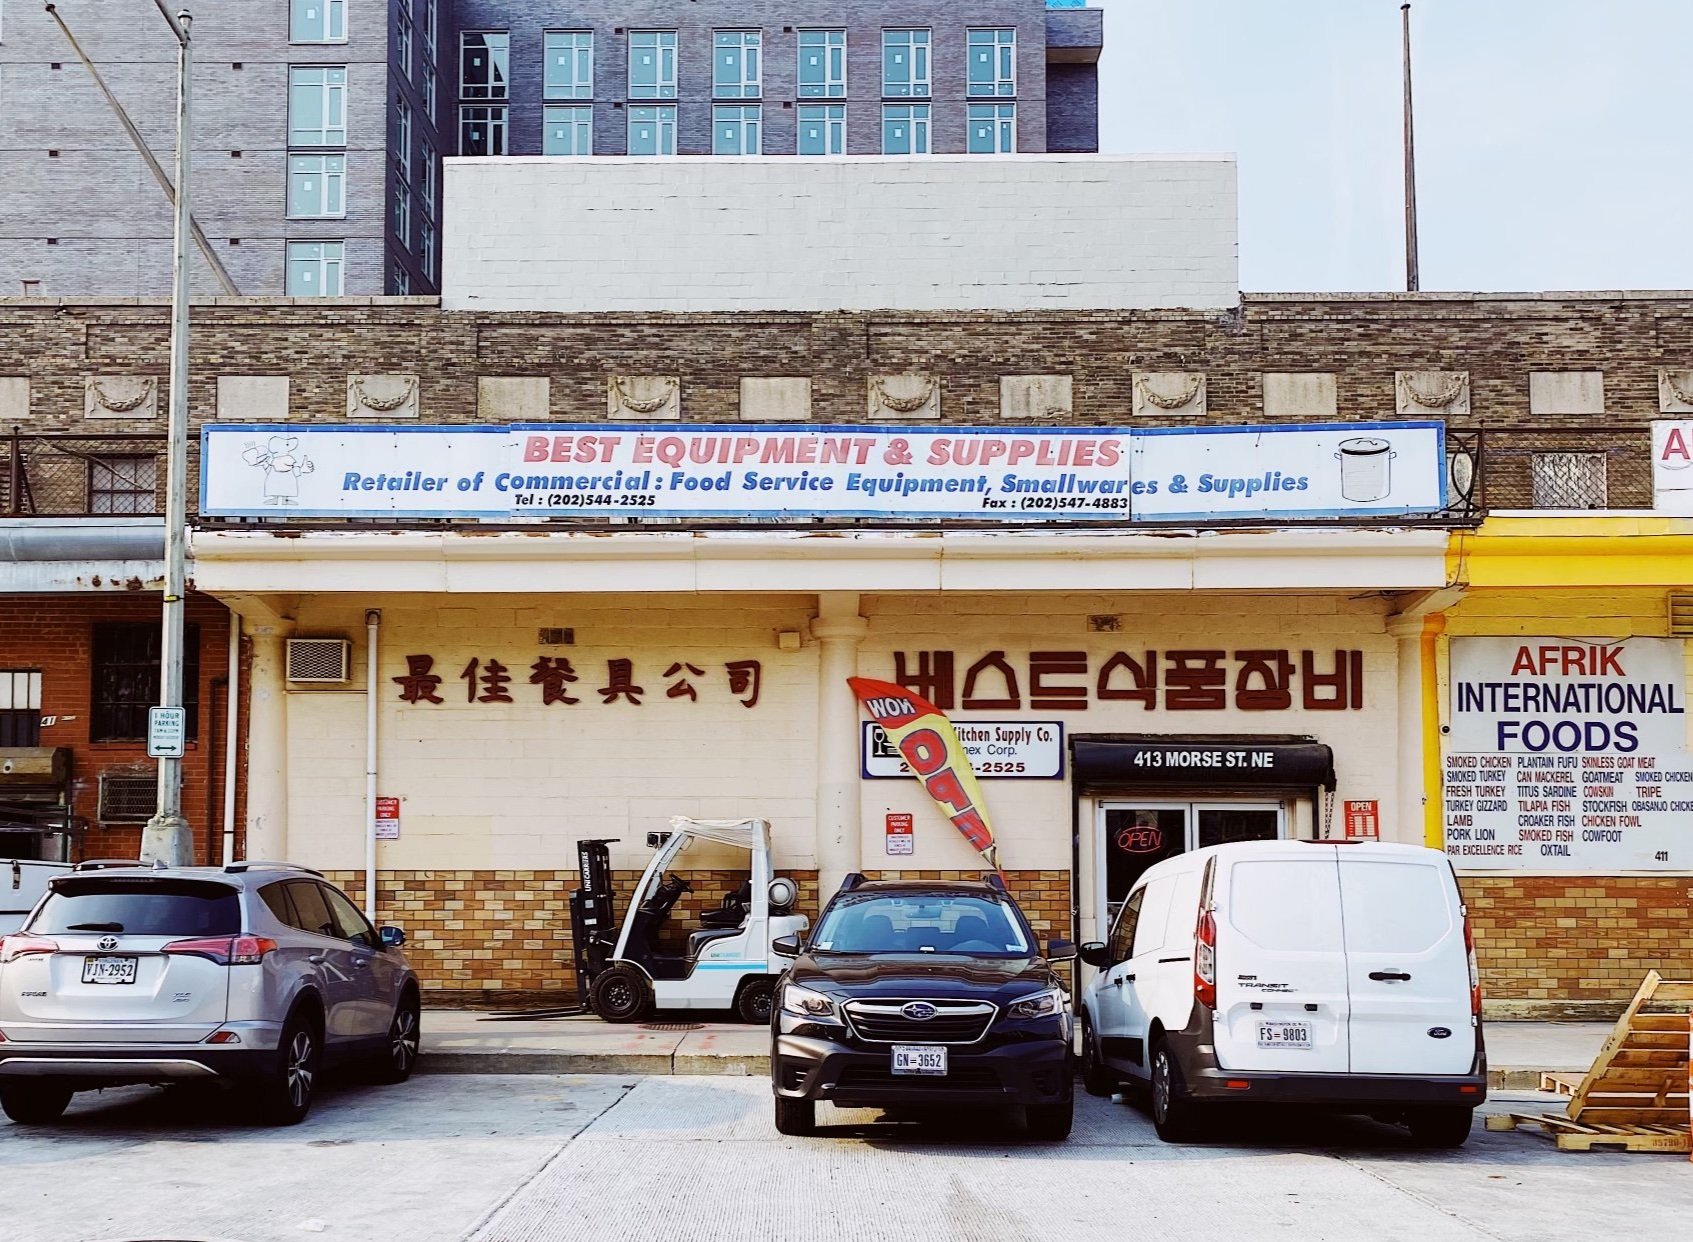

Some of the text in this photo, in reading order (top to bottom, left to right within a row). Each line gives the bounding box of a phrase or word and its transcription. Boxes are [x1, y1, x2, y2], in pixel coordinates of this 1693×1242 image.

[1662, 428, 1693, 461] A
[523, 436, 1121, 468] BEST EQUIPMENT & SUPPLIES
[342, 470, 448, 492] Retailer
[457, 471, 485, 492] of
[669, 470, 732, 491] Food
[742, 470, 834, 492] Service
[846, 473, 992, 497] Equipment,
[1000, 473, 1158, 494] Smallwares
[1168, 474, 1189, 494] &
[1198, 471, 1309, 498] Supplies
[547, 494, 655, 508] (202)544-2525
[1020, 497, 1128, 510] (202)547-4883
[1511, 646, 1627, 677] AFRIK
[391, 653, 761, 708] 最佳餐具公司
[1457, 682, 1685, 714] INTERNATIONAL
[995, 726, 1032, 745] Supply
[1037, 727, 1053, 742] Co.
[1497, 720, 1639, 753] FOODS
[987, 744, 1018, 757] Corp.
[1134, 751, 1274, 768] 413 MORSE ST. NE
[1446, 756, 1512, 768] SMOKED CHICKEN
[1517, 756, 1578, 768] PLANTAIN FUFU
[1581, 756, 1656, 769] SKINLESS GOAT MEAT
[1446, 770, 1506, 782] SMOKED TURKEY
[1516, 771, 1575, 783] CAN MACKEREL
[1581, 771, 1624, 783] GOATMEAT
[1635, 772, 1663, 782] SMOKED
[1446, 786, 1506, 797] FRESH TURKEY
[1517, 786, 1577, 798] TITUS SARDINE
[1583, 786, 1614, 798] COWSKIN
[1636, 786, 1662, 798] TRIPE
[1350, 801, 1372, 811] OPEN
[1446, 800, 1508, 811] TURKEY GIZZARD
[1518, 800, 1571, 812] TILAPIA FISH
[1582, 800, 1628, 812] STOCKFISH
[1631, 801, 1693, 812] OBASANJO CHICKE
[1447, 815, 1473, 826] LAMB
[1517, 815, 1575, 827] CROAKER FISH
[1581, 815, 1642, 827] CHICKEN FOWL
[1117, 830, 1162, 849] OPEN
[1447, 829, 1495, 840] PORK LION
[1518, 829, 1574, 842] SMOKED FISH
[1581, 830, 1623, 842] COWFOOT
[1447, 844, 1523, 855] PAR EXCELLENCE RICE
[1540, 844, 1571, 857] OXTAIL
[1654, 851, 1669, 861] 411
[86, 963, 134, 977] VJN-2952
